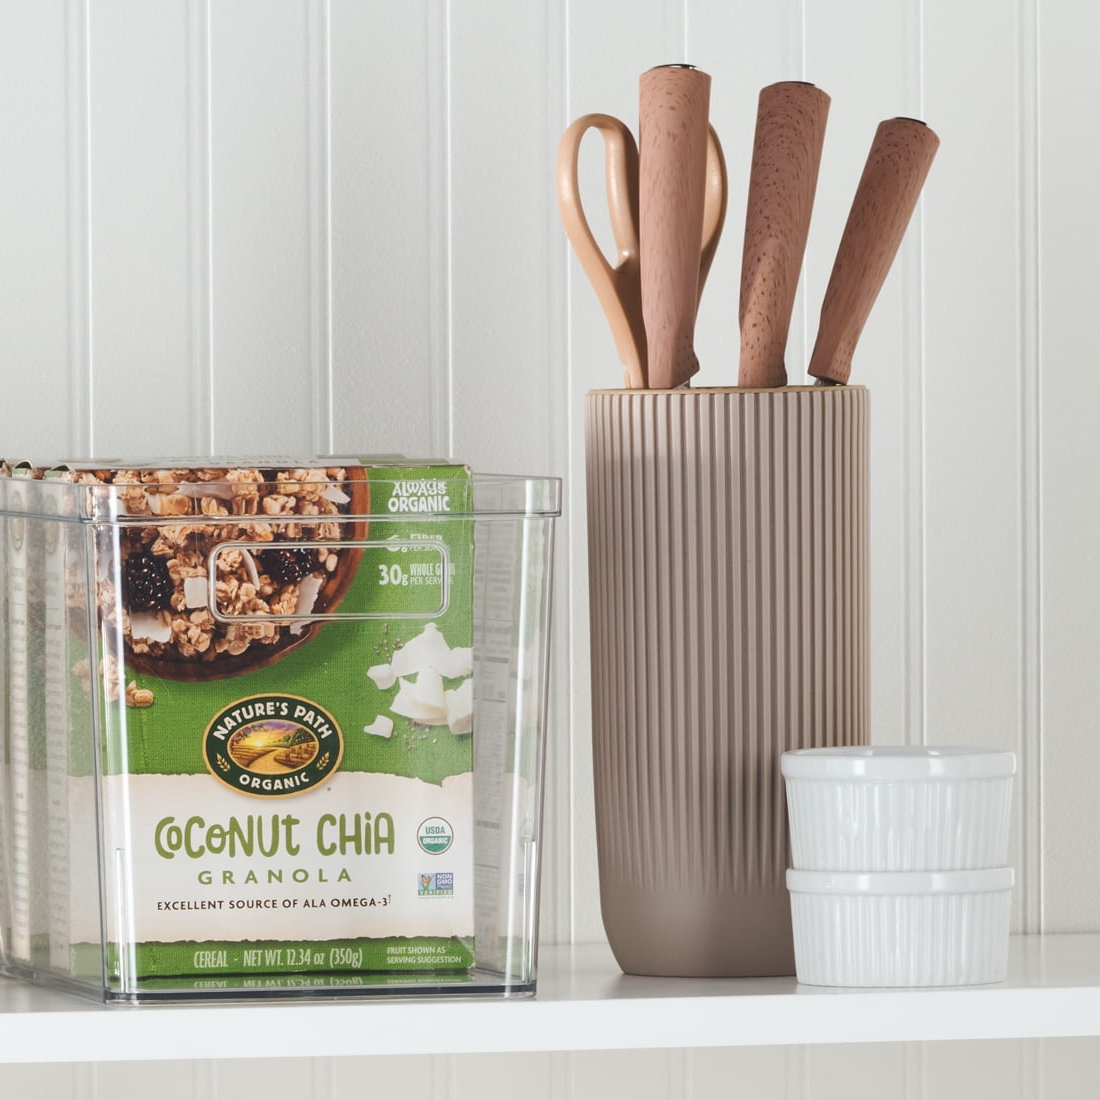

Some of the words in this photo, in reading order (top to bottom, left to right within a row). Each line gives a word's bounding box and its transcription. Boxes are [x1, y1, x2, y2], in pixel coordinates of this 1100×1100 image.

[387, 495, 451, 512] ORGANIC
[378, 564, 408, 586] 30g
[409, 563, 434, 576] WHOLE
[212, 701, 290, 741] NATURE'S
[293, 703, 334, 740] PATH
[238, 771, 310, 792] ORGANIC
[425, 826, 446, 834] USDA
[197, 867, 352, 885] GRANOLA
[157, 900, 224, 911] EXCELLENT
[228, 899, 278, 910] SOURCE
[282, 898, 298, 909] OF
[302, 898, 326, 909] ALA
[193, 950, 229, 968] CEREAL
[243, 950, 263, 967] NET
[264, 949, 284, 967] WT.
[286, 949, 311, 967] 12.34
[313, 952, 325, 966] oz
[329, 947, 363, 968] (350g)
[387, 946, 407, 955] FRUIT
[407, 946, 434, 955] SHOWN
[436, 945, 446, 954] AS
[386, 955, 416, 964] SERVING
[417, 955, 462, 964] SUGGESTION
